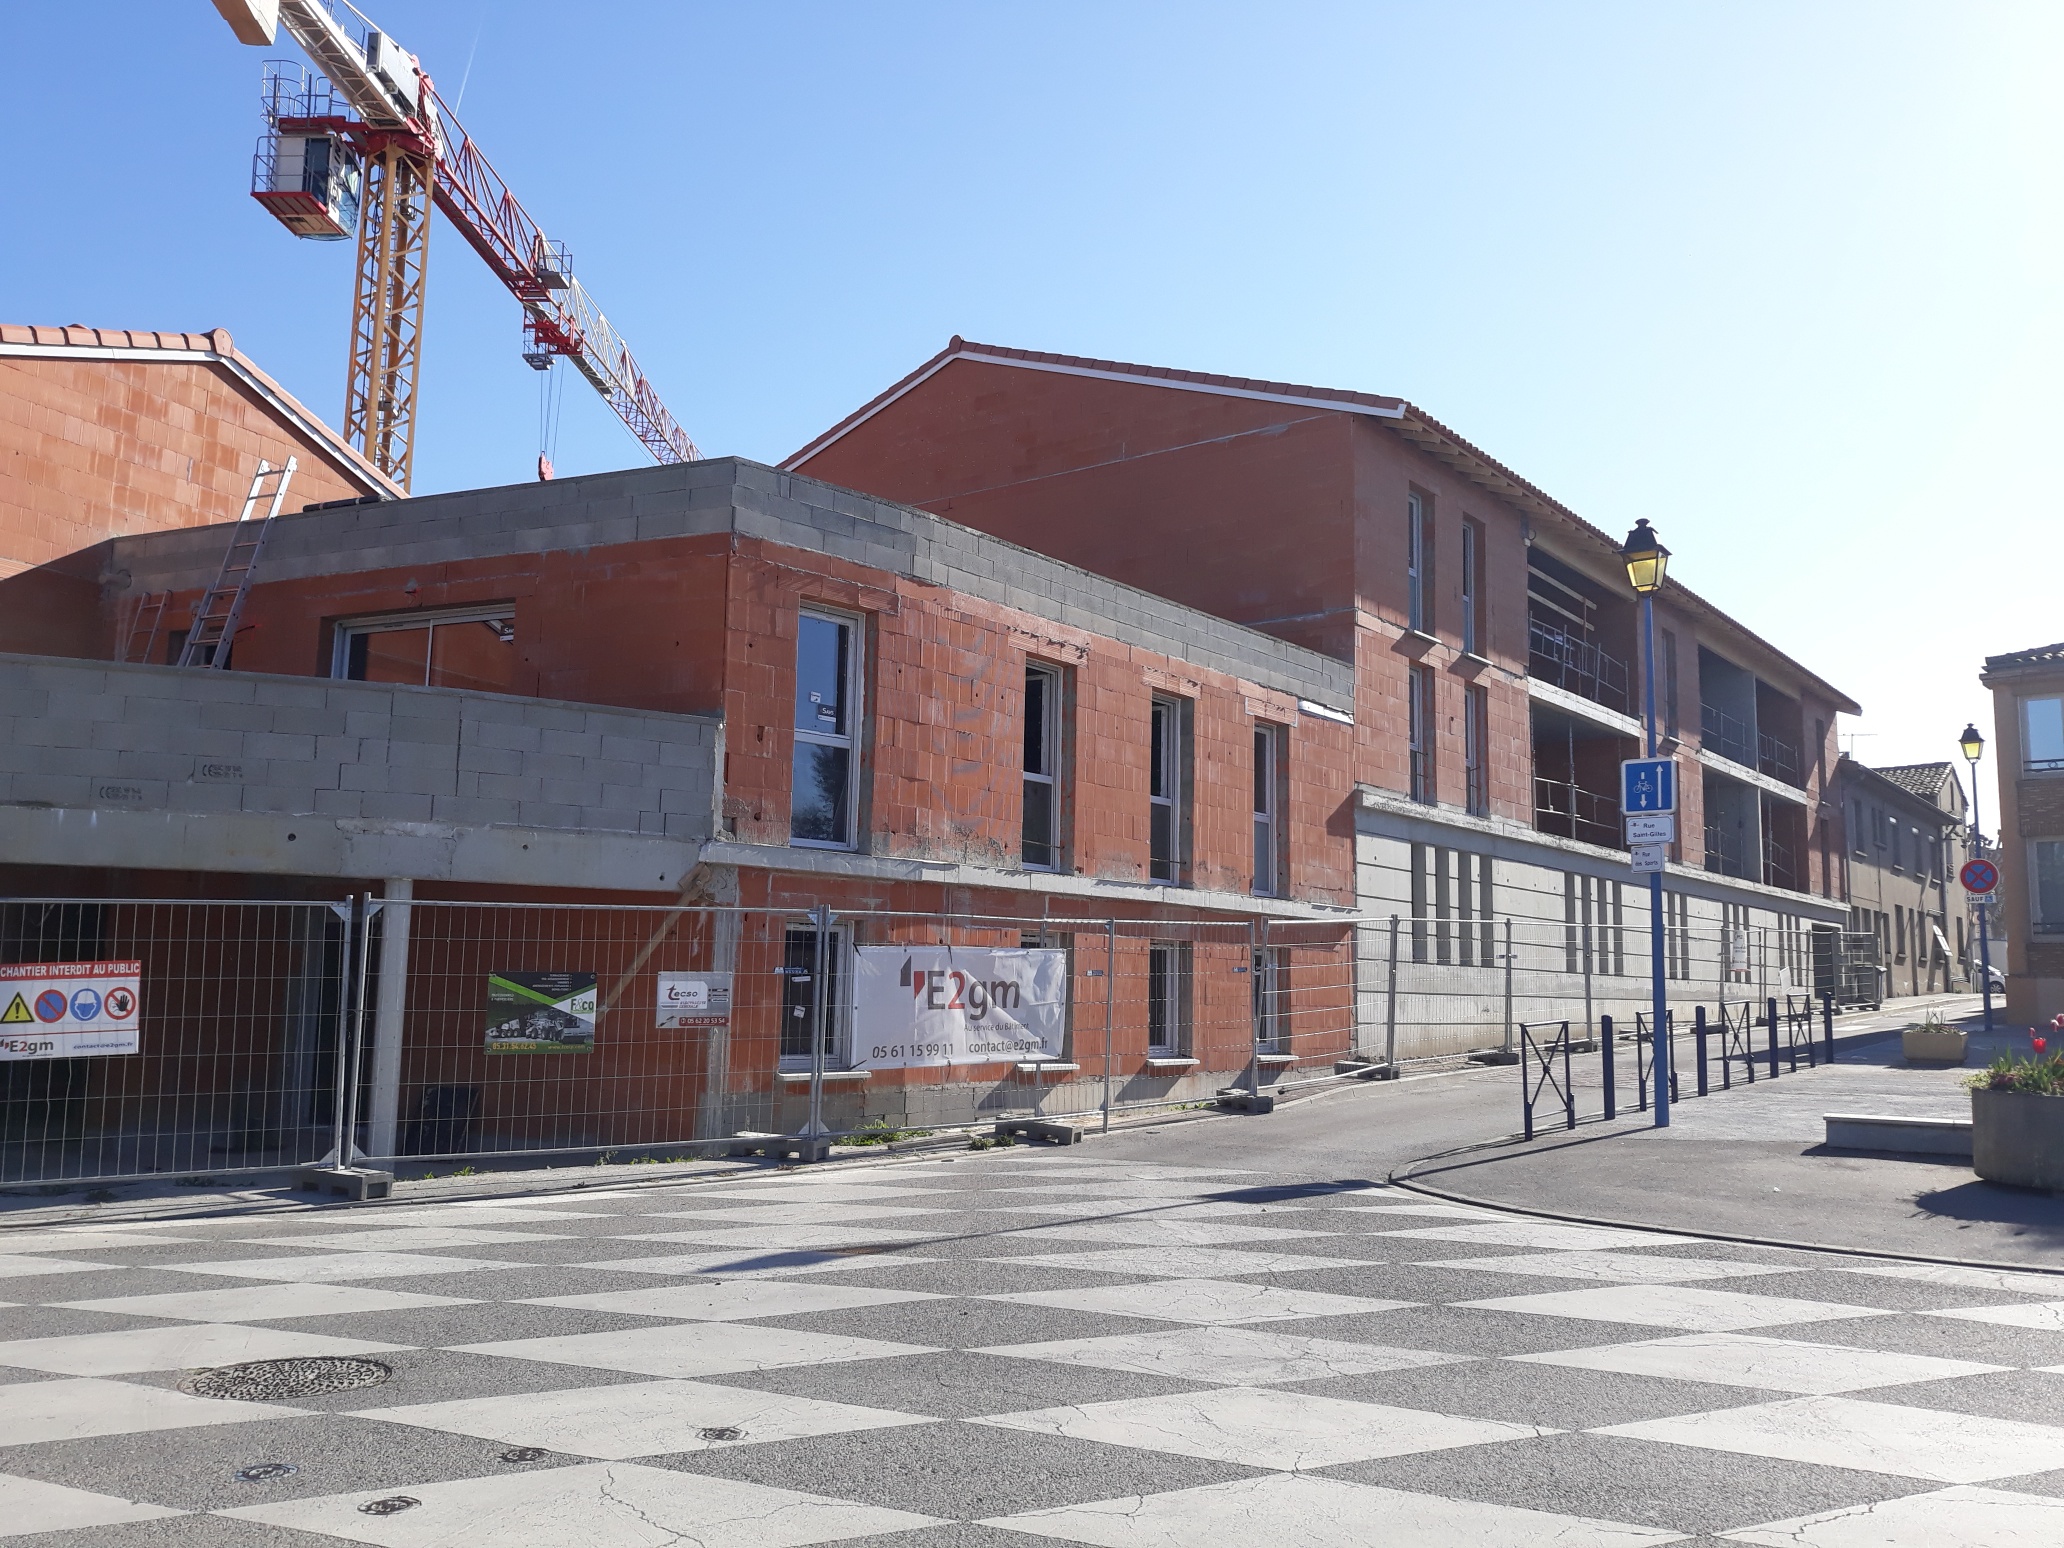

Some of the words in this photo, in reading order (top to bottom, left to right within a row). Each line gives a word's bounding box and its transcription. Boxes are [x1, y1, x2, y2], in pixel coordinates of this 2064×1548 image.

[0, 965, 47, 977] CHANTIER
[49, 964, 92, 976] INTERDIT
[93, 964, 106, 974] AU
[107, 962, 140, 974] PUBLIC
[666, 983, 698, 1001] tecso
[928, 971, 1021, 1021] E2gm
[964, 1022, 973, 1031] Au
[973, 1022, 994, 1031] service
[995, 1021, 1004, 1030] du
[9, 1040, 54, 1054] E2gm
[872, 1045, 887, 1058] 05
[890, 1045, 905, 1057] 61
[911, 1044, 924, 1056] 15
[926, 1043, 941, 1056] 99
[942, 1043, 954, 1055] 11
[969, 1036, 1048, 1054] contact@e2gm.fr
